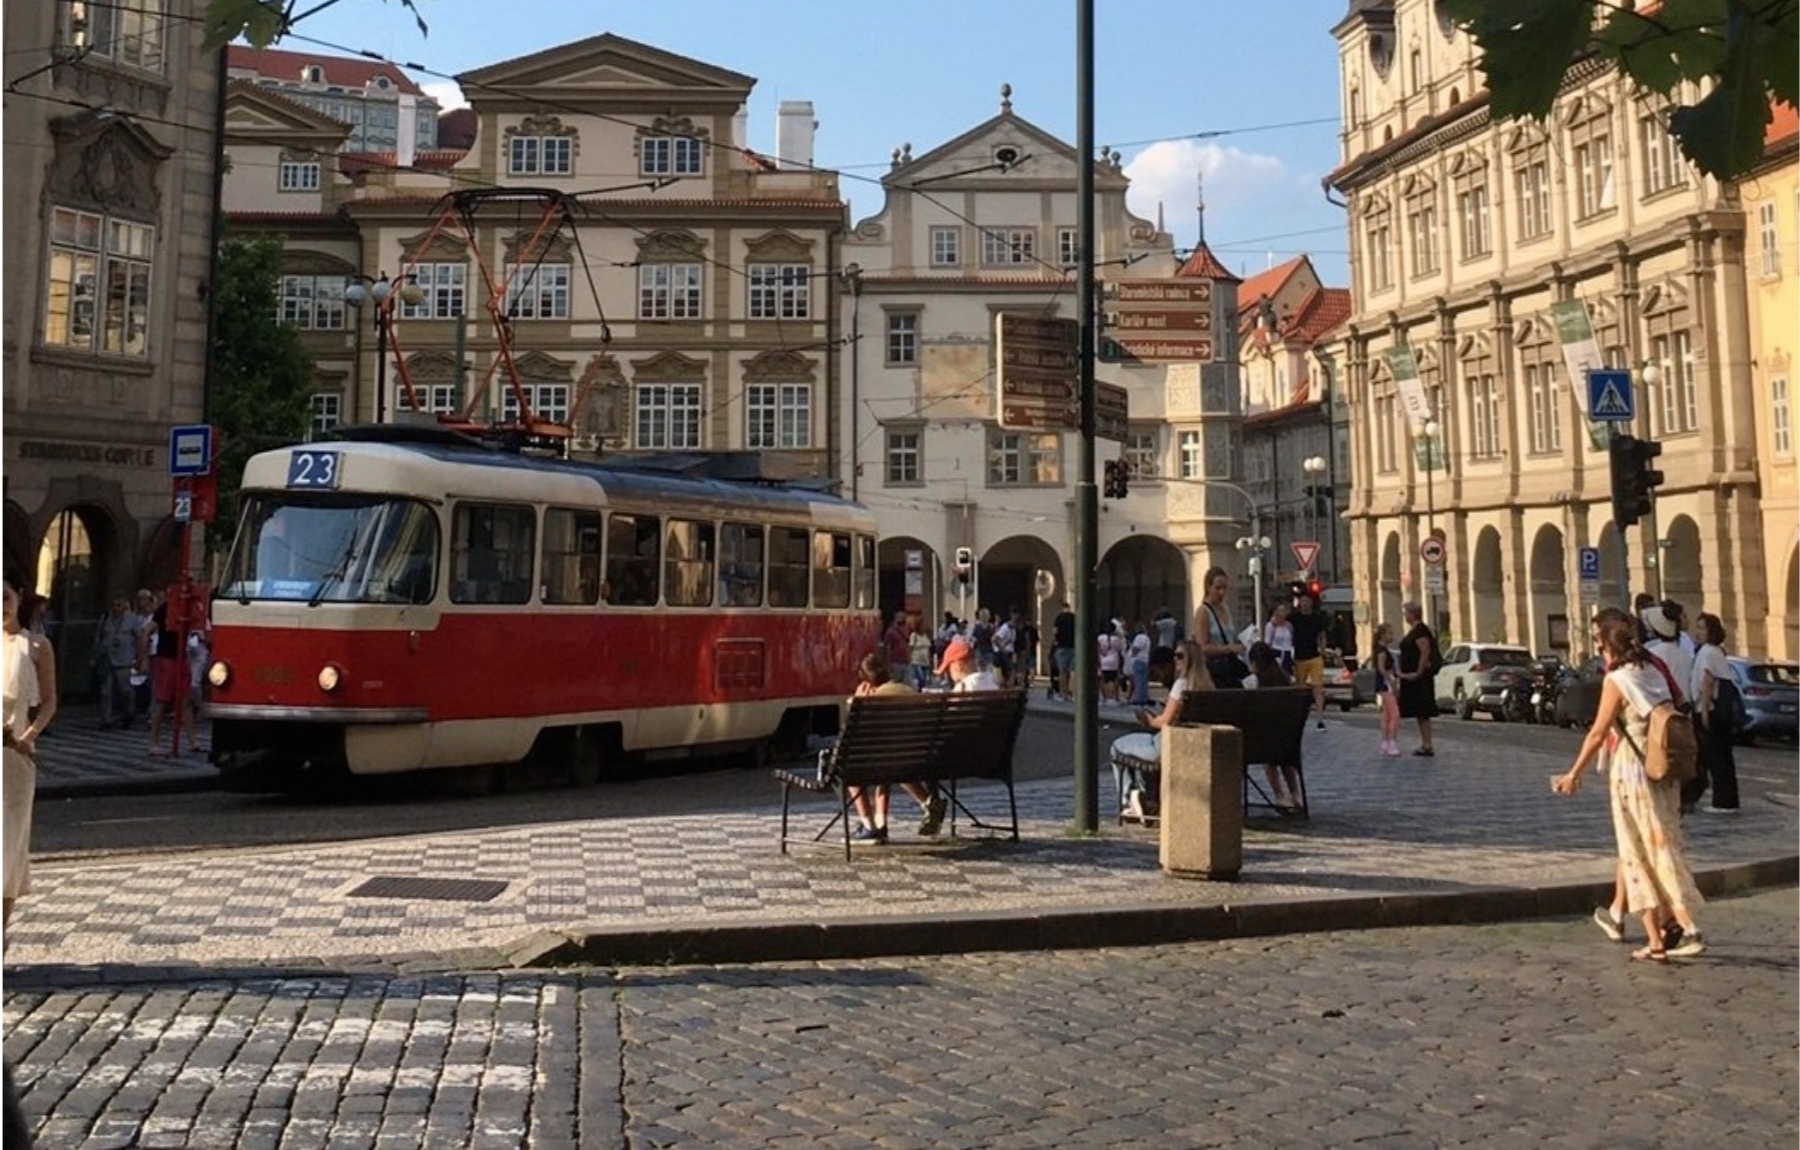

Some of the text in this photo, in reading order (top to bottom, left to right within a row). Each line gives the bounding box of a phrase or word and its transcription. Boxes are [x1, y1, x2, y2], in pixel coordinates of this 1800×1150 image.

[293, 453, 335, 485] 23
[174, 497, 191, 517] 23
[1582, 550, 1596, 570] P
